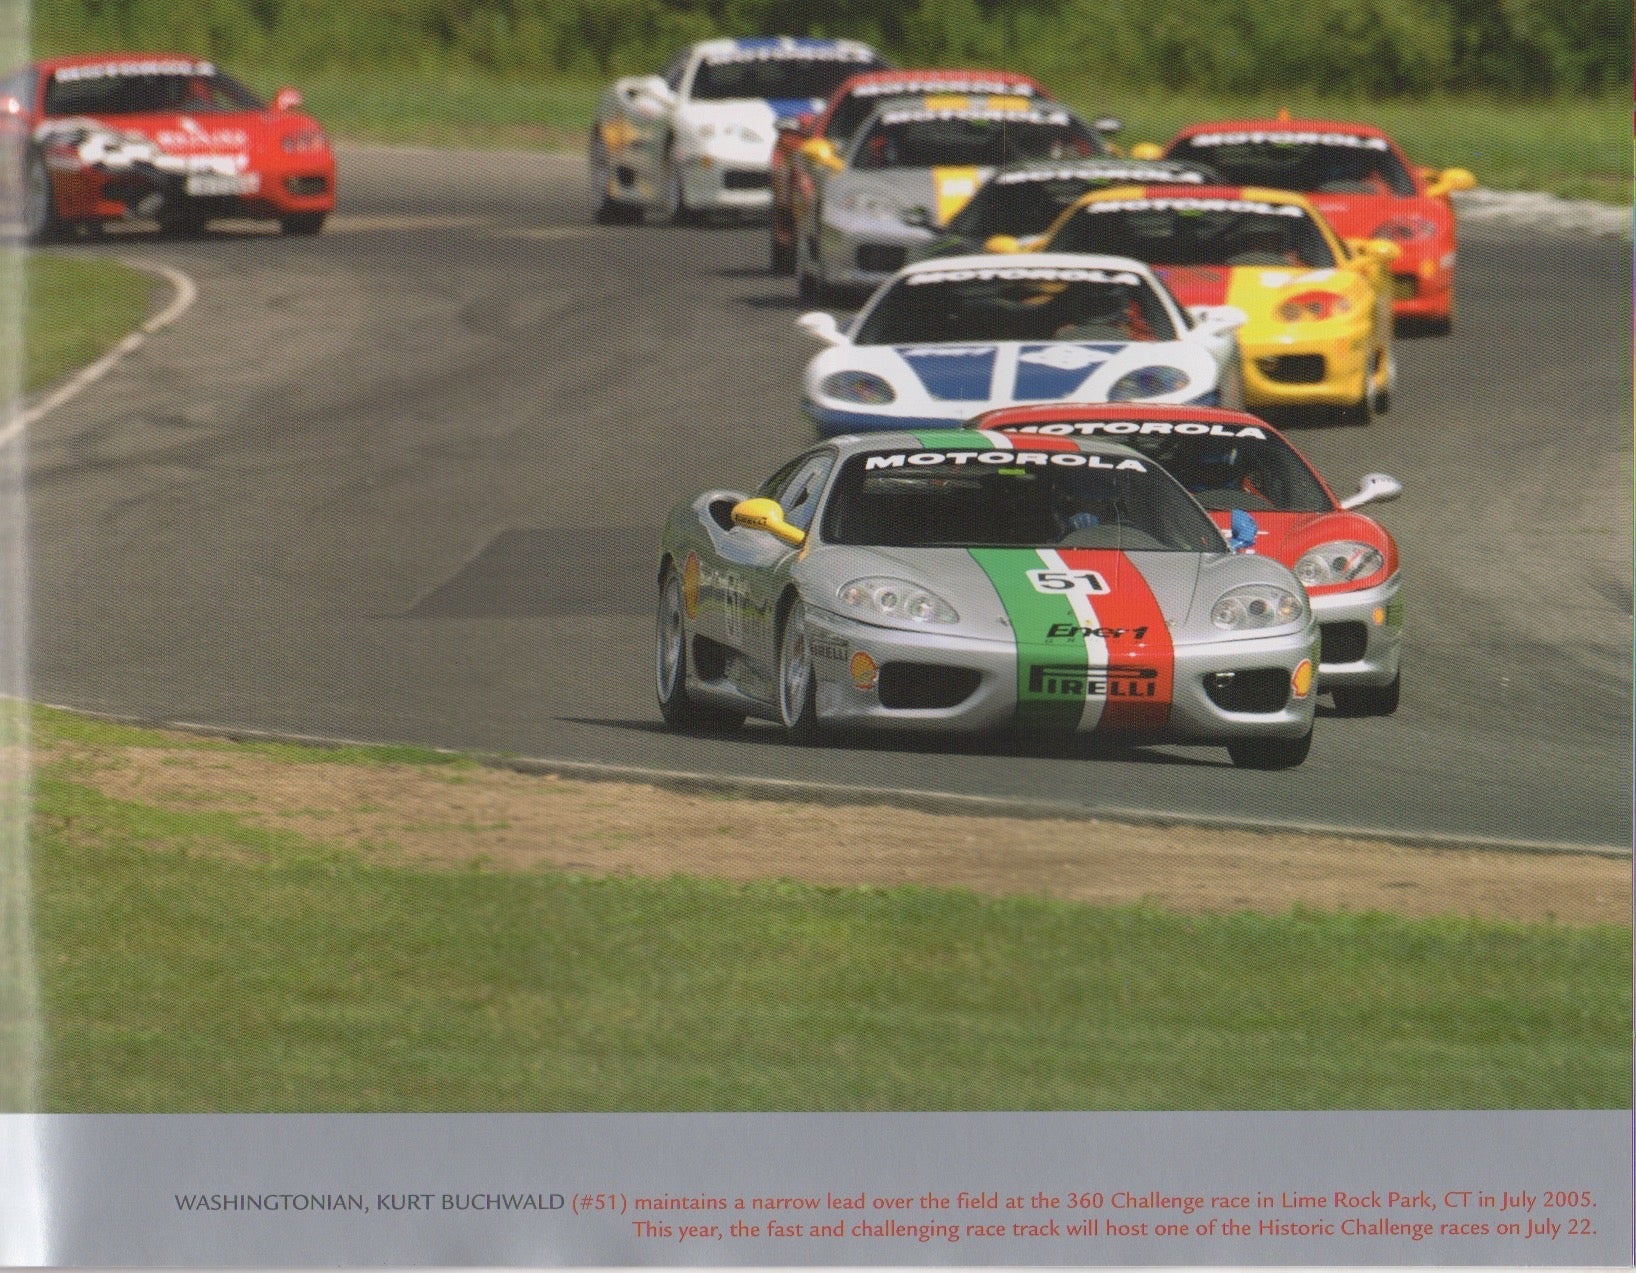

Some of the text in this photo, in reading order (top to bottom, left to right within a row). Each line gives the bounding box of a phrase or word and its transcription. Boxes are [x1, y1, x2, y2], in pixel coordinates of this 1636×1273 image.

[865, 452, 1148, 473] MOTOROLA
[1038, 573, 1103, 590] 51
[1046, 623, 1148, 640] Ener1
[1029, 664, 1158, 697] PIRELLI
